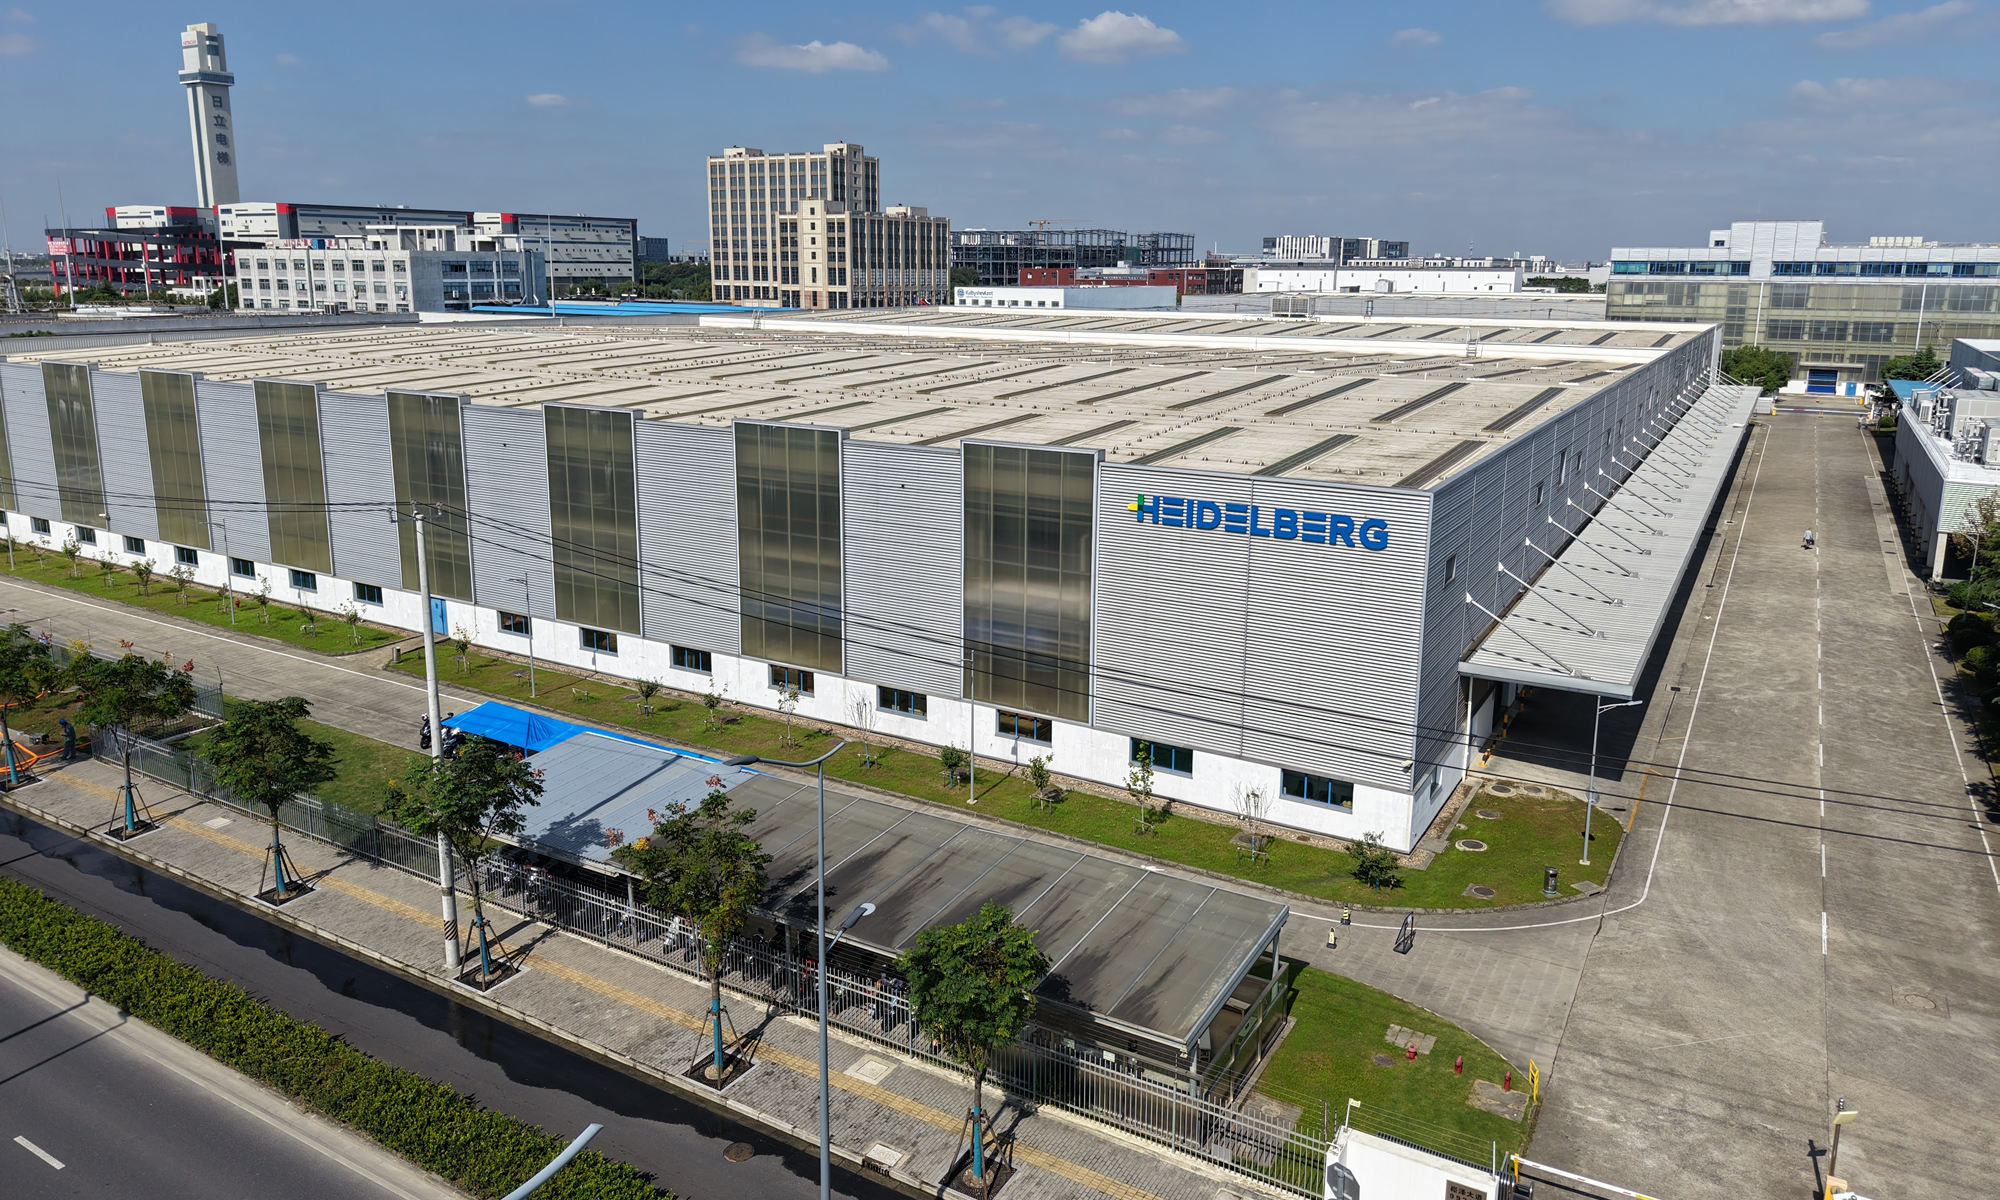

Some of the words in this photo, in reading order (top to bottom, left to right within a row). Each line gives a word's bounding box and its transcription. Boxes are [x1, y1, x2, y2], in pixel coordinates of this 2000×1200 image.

[212, 95, 229, 164] 日立电梯
[1128, 494, 1389, 550] HEIDELBERG
